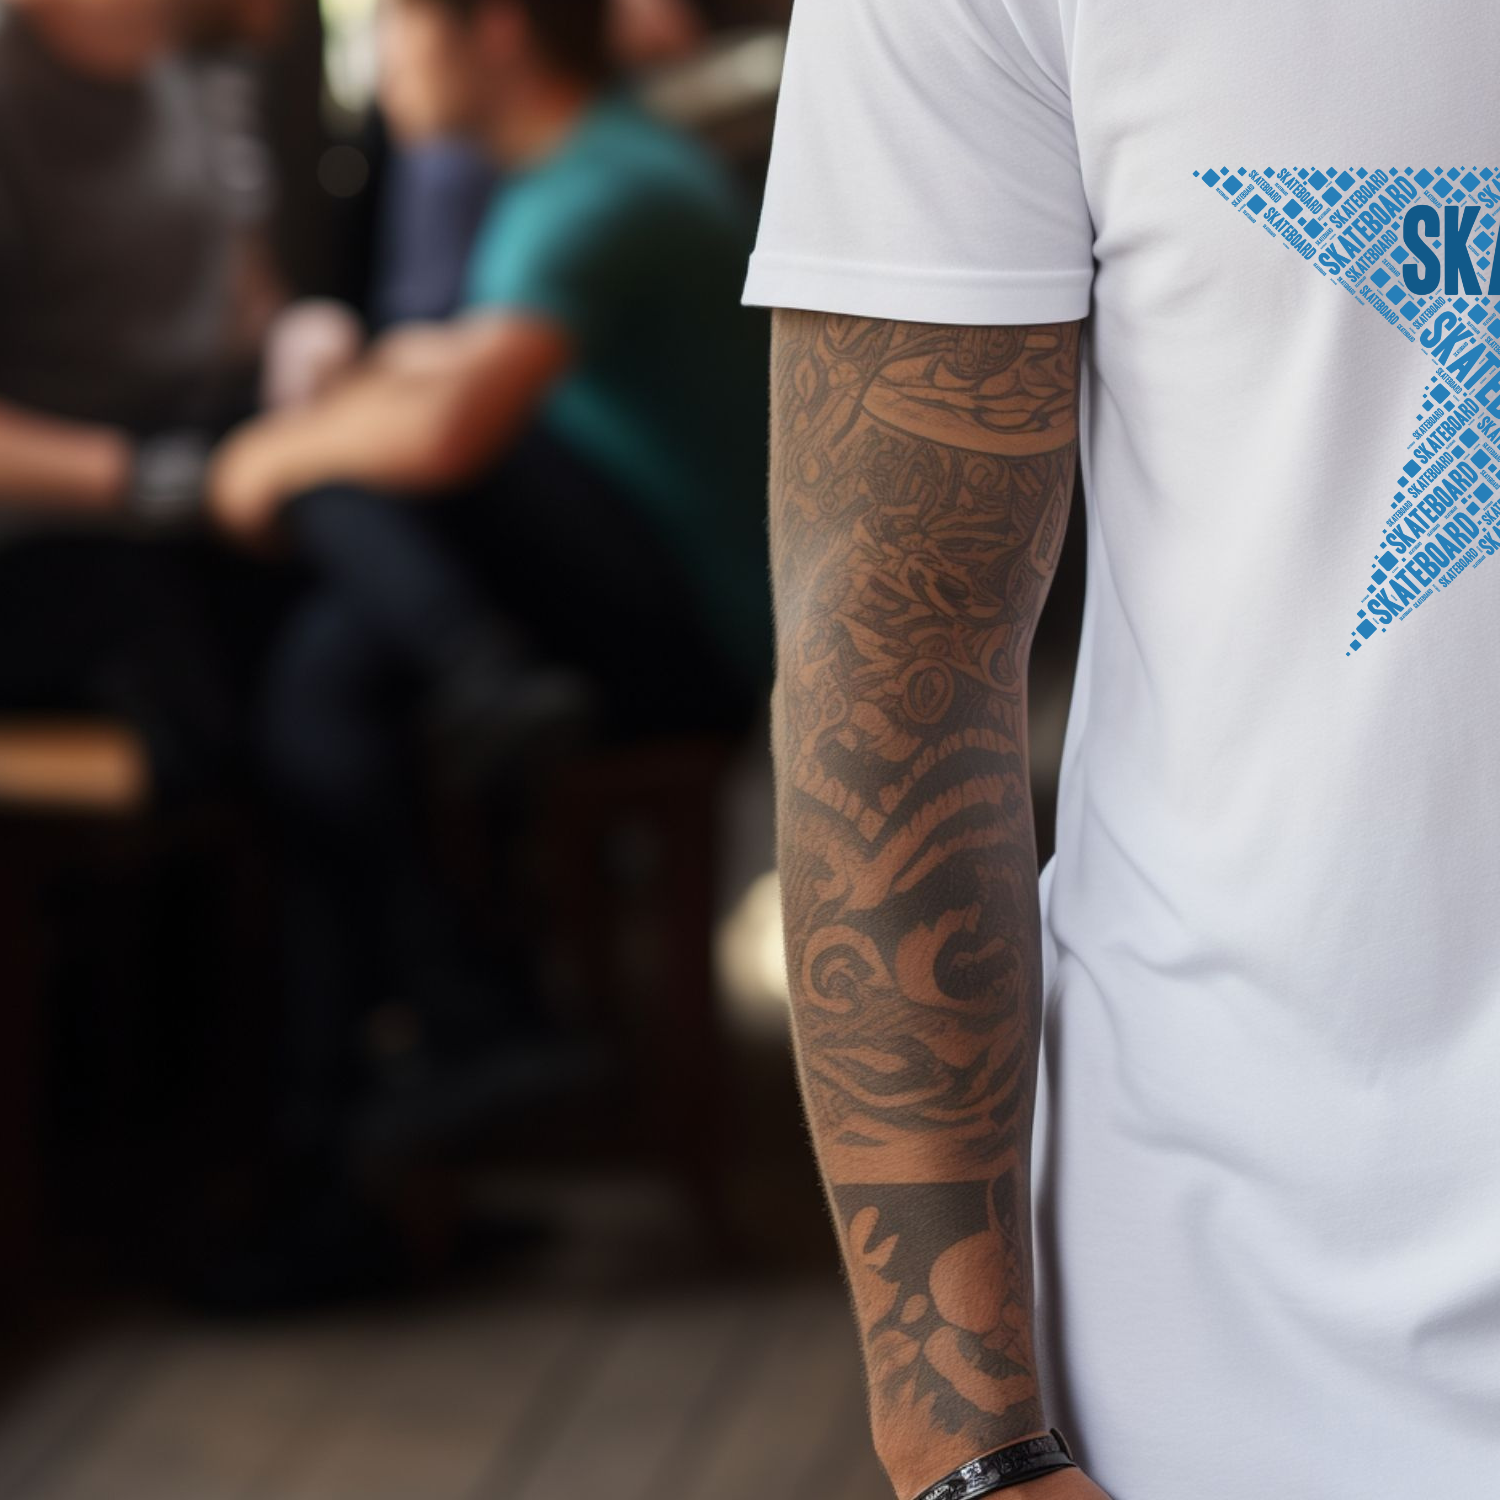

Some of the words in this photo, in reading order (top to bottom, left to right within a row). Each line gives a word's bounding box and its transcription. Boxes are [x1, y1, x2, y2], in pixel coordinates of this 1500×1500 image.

[1249, 170, 1282, 203] SKATEBOARD
[1277, 168, 1323, 214] SKATEBOARD
[1329, 169, 1388, 228] SKATEBOARD
[1264, 207, 1316, 260] SKATEBOARD
[1318, 176, 1417, 275] SKATEBOARD
[1345, 230, 1398, 282] SKATEBOARD
[1360, 285, 1399, 325] SKATEBOARD
[1412, 296, 1446, 330] SKATEBOARD
[1412, 408, 1444, 440] SKATEBOARD
[1414, 398, 1479, 464] SKATEBOARD
[1408, 452, 1454, 498] SKATEBOARD
[1386, 462, 1478, 554] SKATEBOARD
[1367, 512, 1479, 624] SKATEBOARD
[1438, 548, 1478, 587] SKATEBOARD
